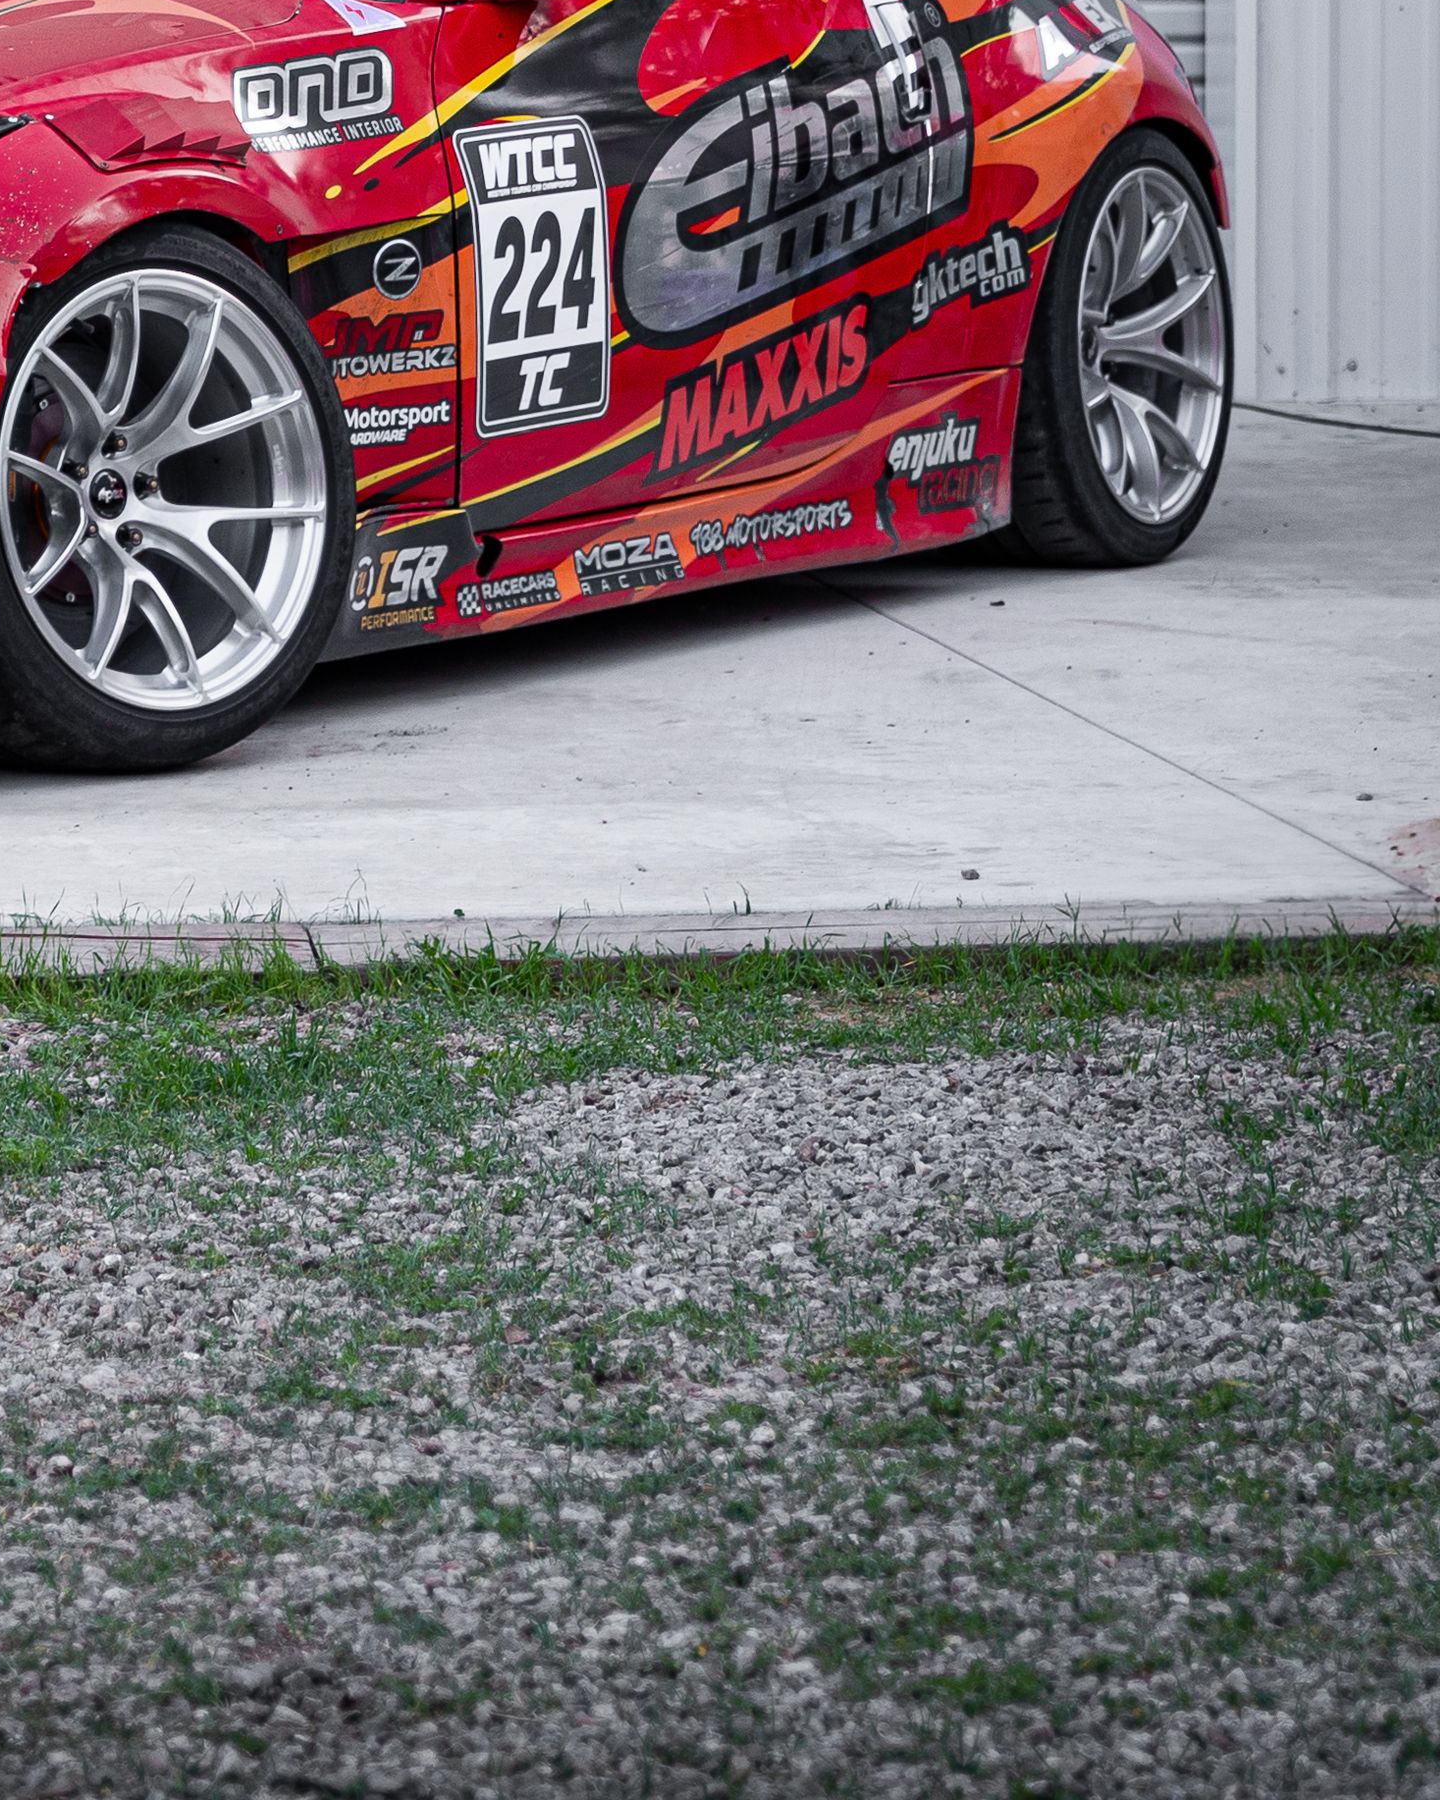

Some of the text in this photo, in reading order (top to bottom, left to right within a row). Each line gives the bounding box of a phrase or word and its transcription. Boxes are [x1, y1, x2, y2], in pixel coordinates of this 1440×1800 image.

[343, 115, 404, 141] INTERIOR
[478, 133, 577, 190] WTCC
[488, 207, 596, 346] 224
[911, 231, 1022, 325] gktech
[979, 267, 1026, 298] com
[518, 352, 571, 411] TC
[659, 304, 870, 472] MAXXIS
[344, 400, 451, 430] Motorsport
[350, 428, 407, 446] ARDWARE
[887, 418, 977, 481] enjuku
[726, 499, 854, 549] MOTORSPORTS
[573, 532, 680, 575] MOZA
[481, 571, 557, 601] RACECARS
[580, 564, 686, 597] RACING
[360, 605, 436, 631] PERFORMANCE
[484, 591, 562, 613] UNLIMITED
